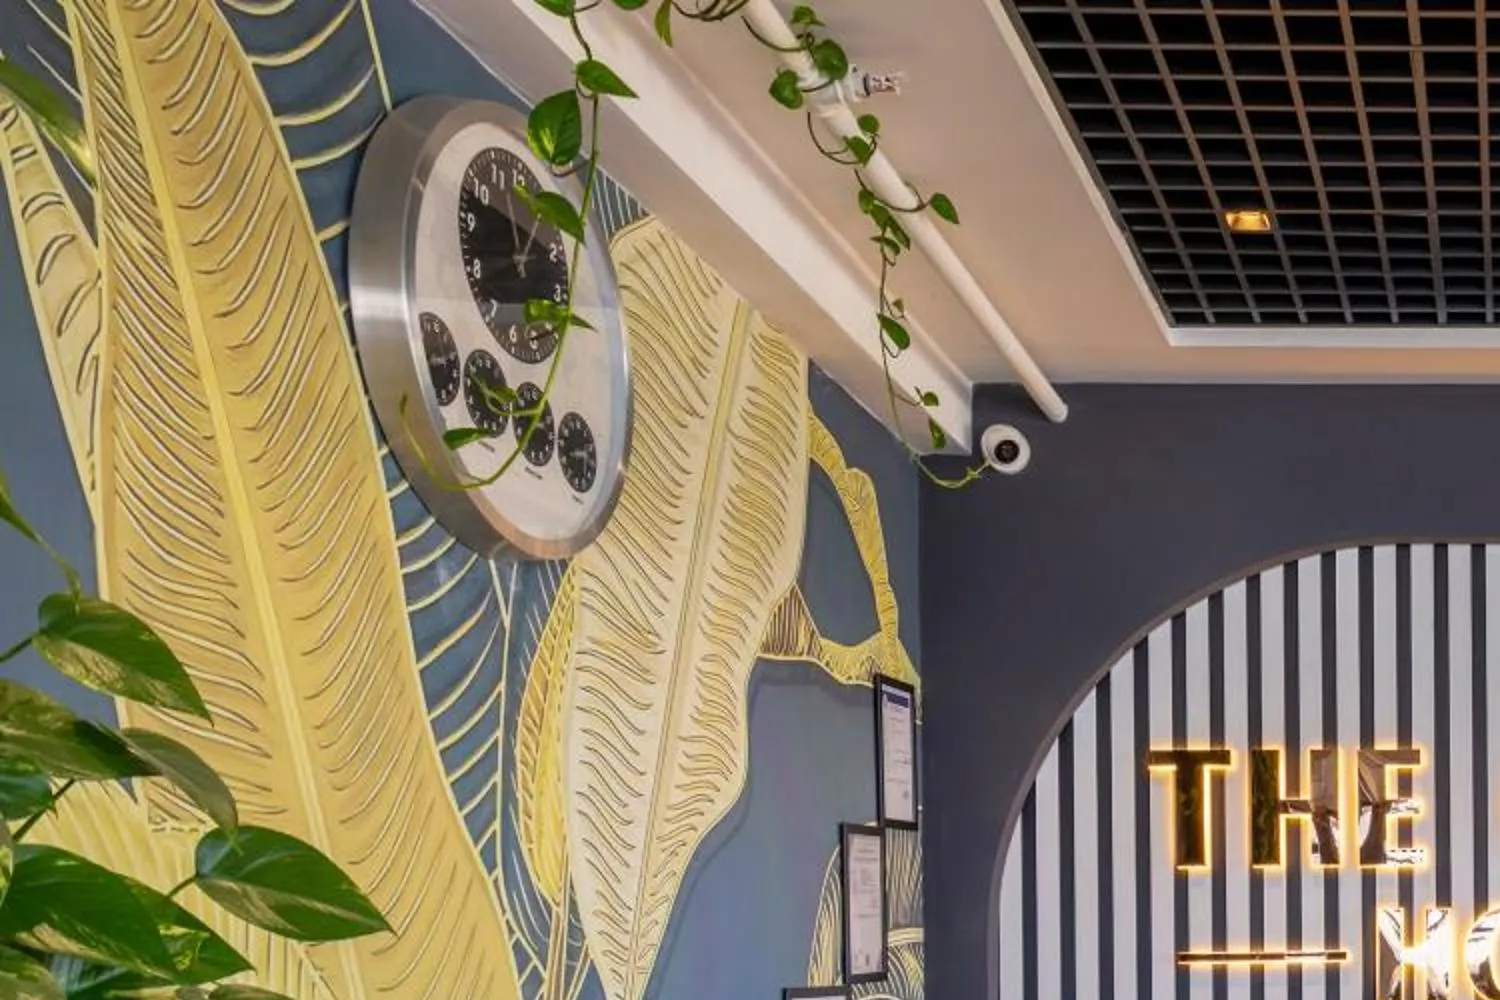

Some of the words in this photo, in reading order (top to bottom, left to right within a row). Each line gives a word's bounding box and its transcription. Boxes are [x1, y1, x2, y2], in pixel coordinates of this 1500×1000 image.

[491, 163, 505, 190] 11
[473, 177, 489, 206] 10
[467, 212, 476, 232] 9
[549, 243, 558, 262] 2
[473, 258, 481, 278] 8
[509, 324, 518, 342] 6
[1149, 748, 1424, 868] THE
